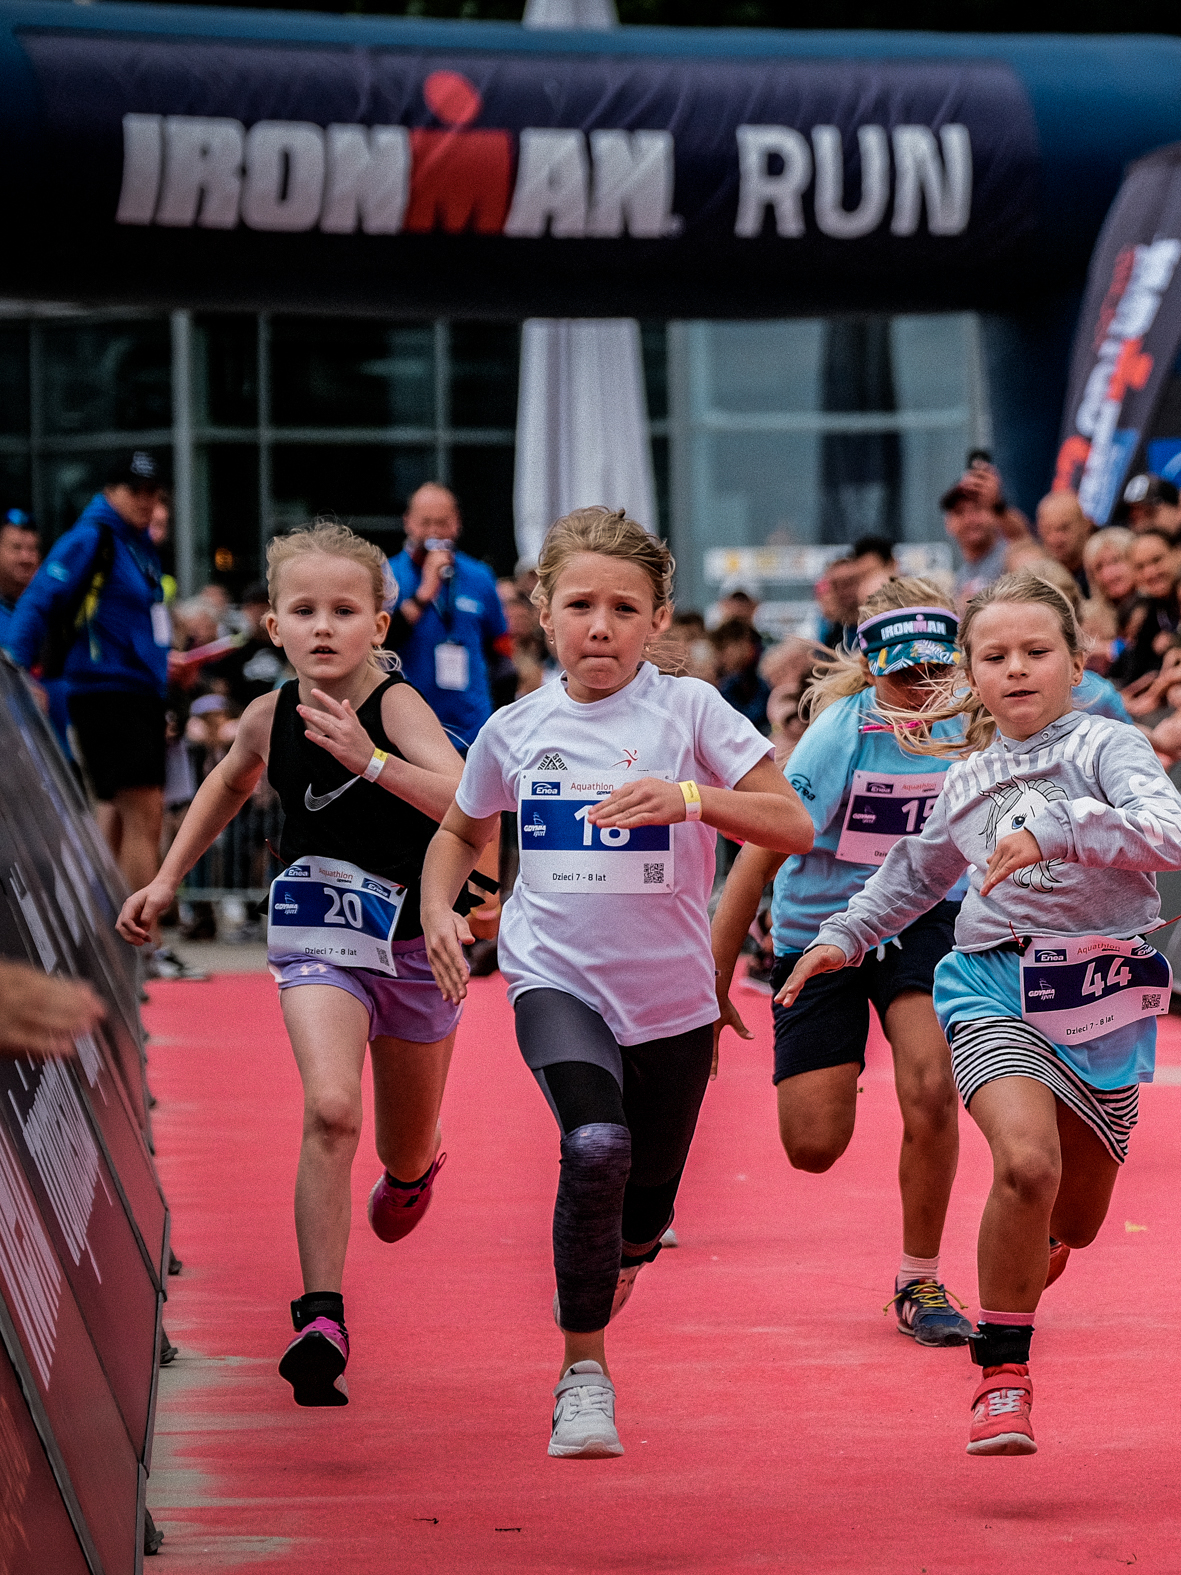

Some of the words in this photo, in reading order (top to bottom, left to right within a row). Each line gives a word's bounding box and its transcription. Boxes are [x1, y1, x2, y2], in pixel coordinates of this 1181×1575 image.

[116, 72, 674, 239] IRONMAN
[734, 123, 974, 239] RUN
[881, 614, 947, 641] IRONMAN
[570, 782, 614, 792] Aquathlon
[288, 869, 309, 877] Enea
[319, 868, 354, 880] Aquathlon
[552, 873, 574, 881] Dzieci
[576, 873, 580, 881] 7
[595, 873, 606, 881] lat
[324, 887, 363, 929] 20
[347, 947, 357, 956] lat
[1077, 943, 1121, 955] Aquathlon
[1081, 957, 1132, 997] 44
[1066, 1024, 1088, 1036] Dzieci
[1100, 1018, 1105, 1026] 8
[1106, 1015, 1114, 1024] lat
